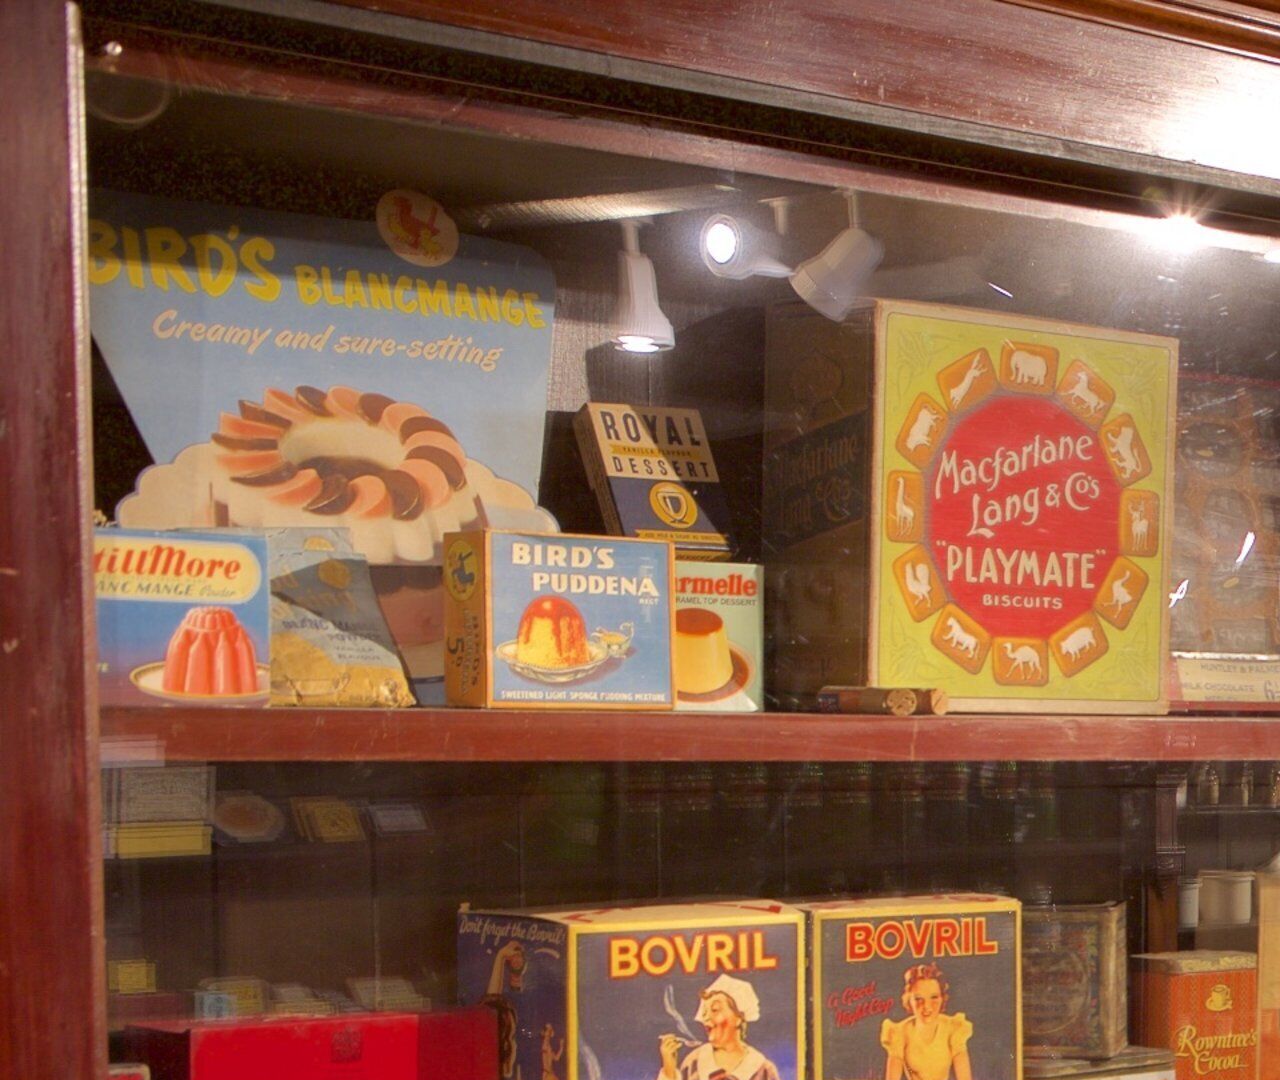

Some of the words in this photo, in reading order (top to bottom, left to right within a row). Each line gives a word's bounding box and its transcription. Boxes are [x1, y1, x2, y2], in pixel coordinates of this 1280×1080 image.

[88, 217, 282, 300] BIRD'S
[295, 264, 547, 331] BLANCMANGE
[152, 309, 272, 353] Creamy
[275, 324, 335, 354] and
[334, 332, 504, 373] sure-setting
[600, 410, 701, 447] ROYAL
[612, 456, 709, 477] DESSERT
[935, 434, 1094, 500] Macfarlane
[967, 487, 1040, 539] Lang
[1045, 486, 1061, 507] &
[512, 542, 615, 569] BIRD'S
[136, 581, 193, 596] MANGE
[533, 572, 659, 597] PUDDENA
[720, 598, 756, 606] DESSERT
[982, 594, 1063, 610] BISCUITS
[545, 692, 567, 700] LIGHT
[846, 917, 998, 962] BOVRIL
[610, 932, 777, 979] BOVRIL
[1176, 1024, 1258, 1058] Rowntree's
[1194, 1051, 1248, 1075] Cocoa
